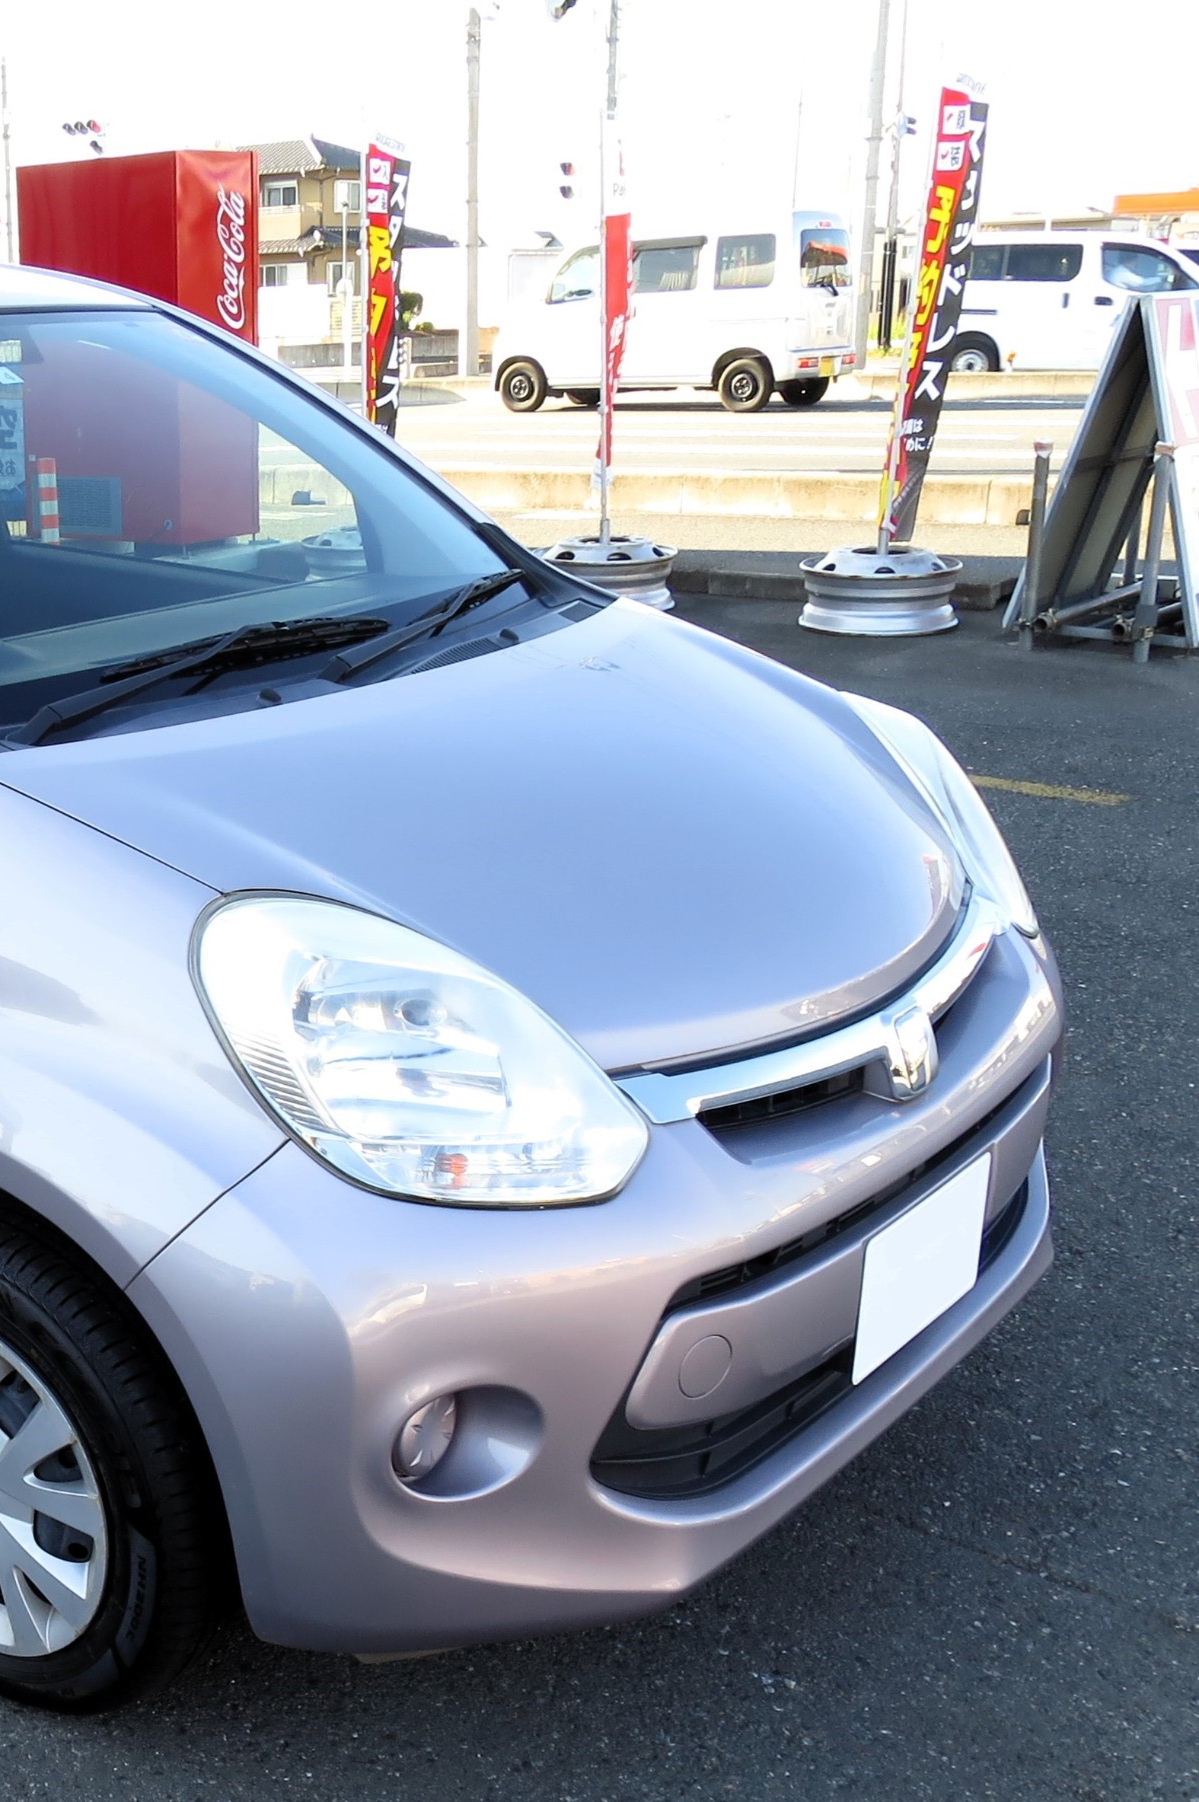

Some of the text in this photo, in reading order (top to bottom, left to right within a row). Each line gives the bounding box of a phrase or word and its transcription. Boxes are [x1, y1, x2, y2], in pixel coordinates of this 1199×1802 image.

[216, 182, 245, 329] Coca-Cola
[915, 120, 985, 400] スタッドレス
